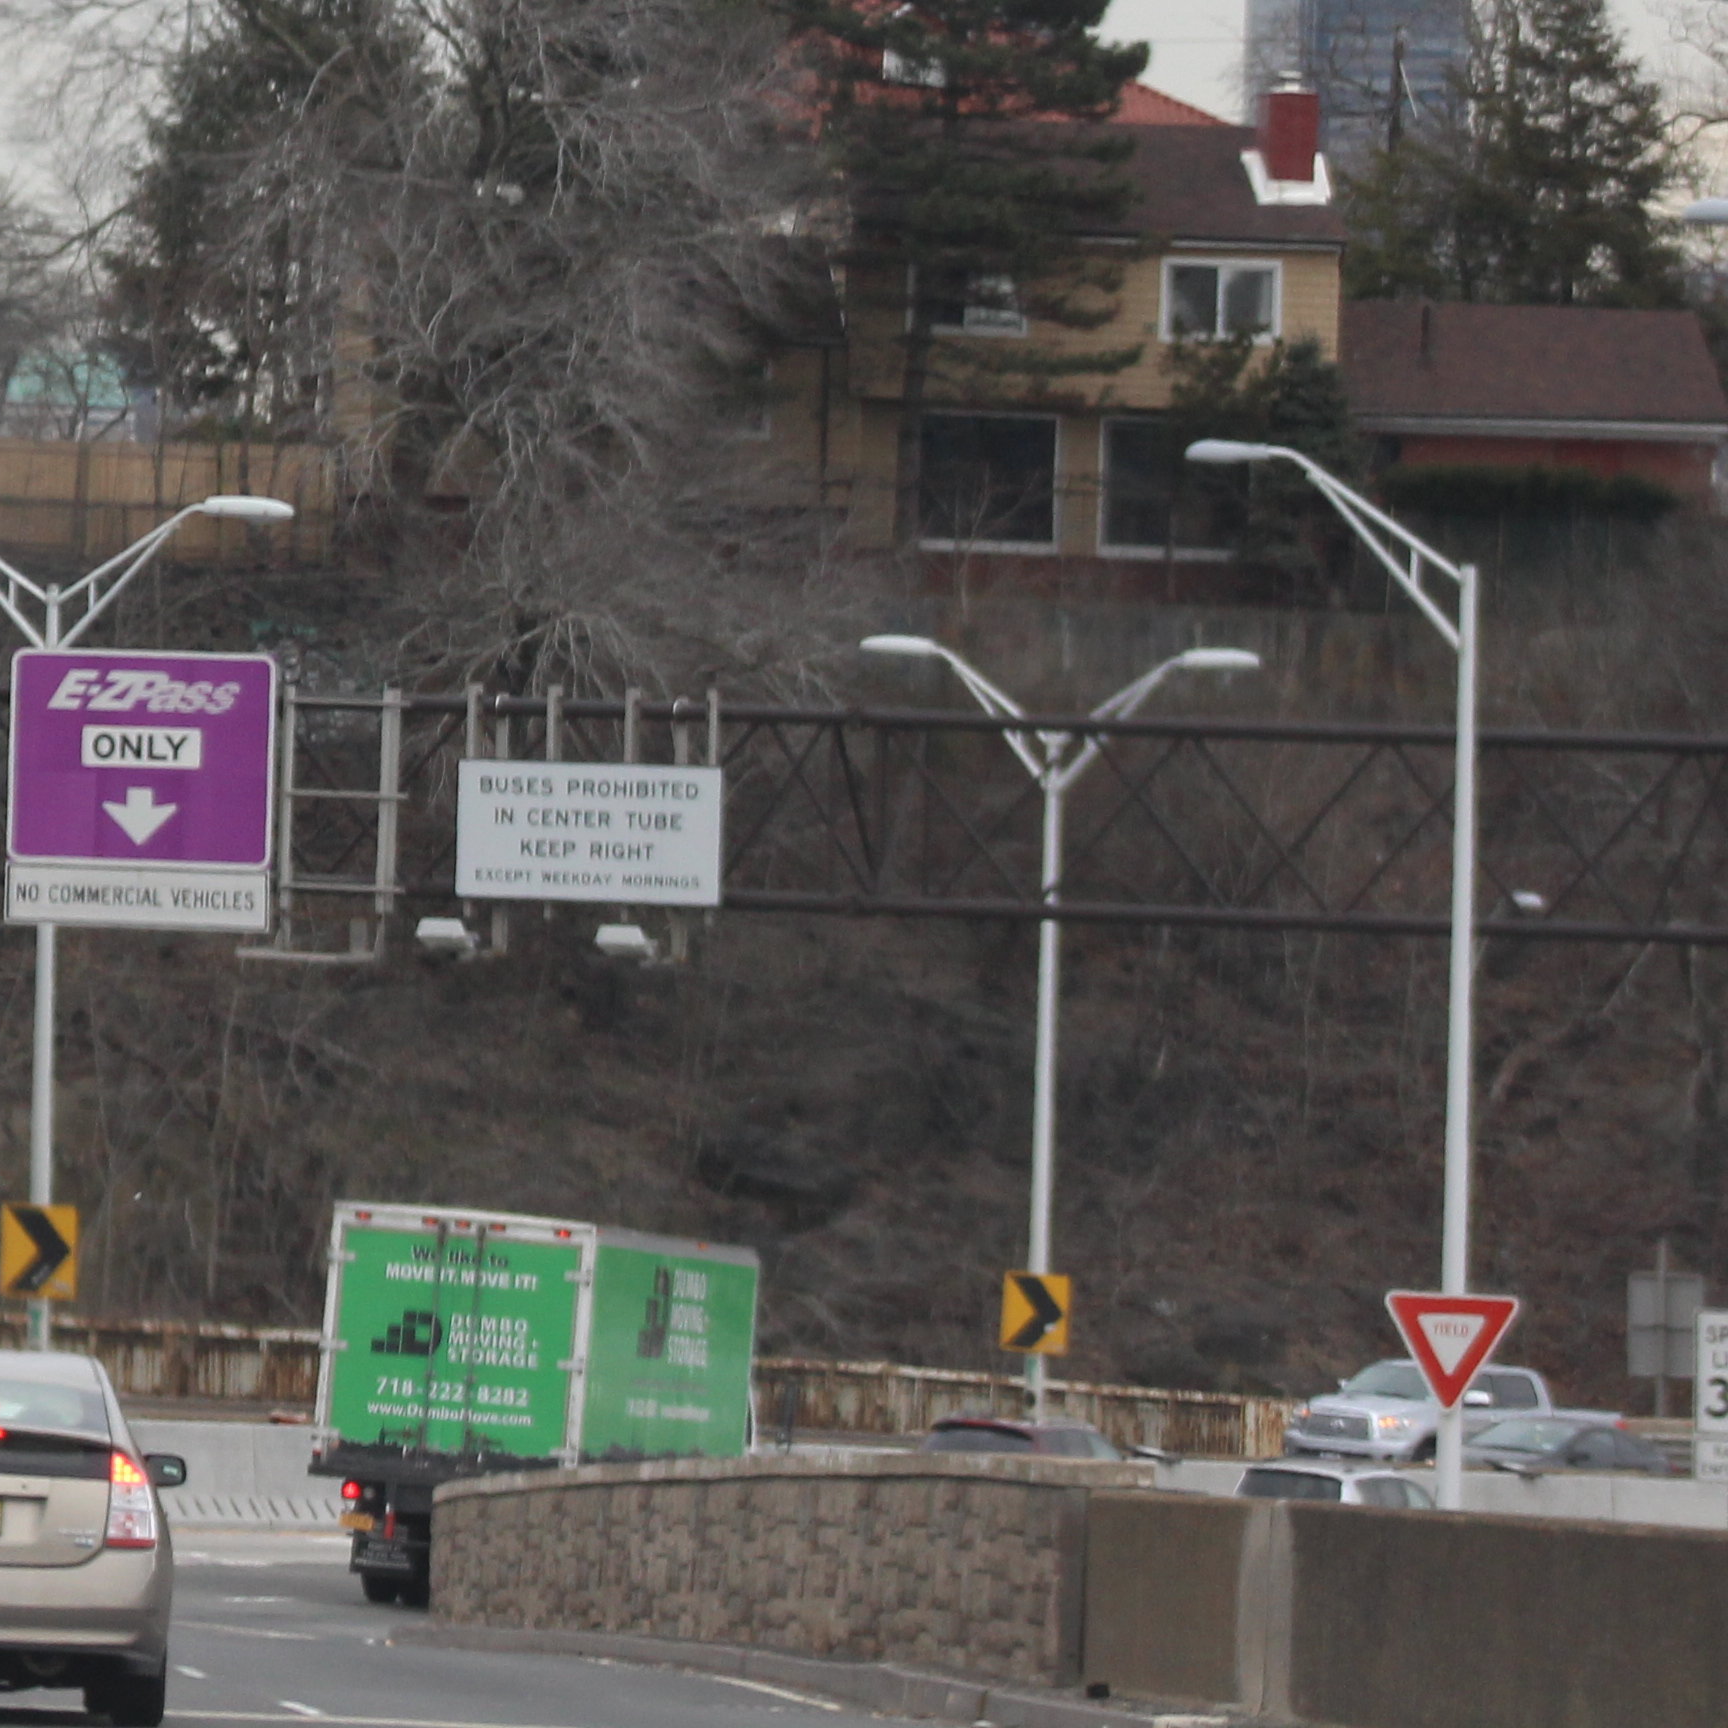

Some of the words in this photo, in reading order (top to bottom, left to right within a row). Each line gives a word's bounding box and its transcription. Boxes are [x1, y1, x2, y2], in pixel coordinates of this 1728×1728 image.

[47, 669, 240, 714] E-ZPass
[93, 733, 188, 761] ONLY
[479, 775, 553, 795] BUSES
[566, 778, 699, 800] PROHIBITED
[494, 807, 514, 824] IN
[526, 808, 611, 829] CENTER
[625, 811, 683, 831] TUBE
[520, 839, 576, 858] KEEP
[589, 841, 655, 861] RIGHT
[474, 868, 532, 882] EXCEPT
[541, 871, 612, 886] WEEKDAY
[621, 874, 700, 890] MORNINGS
[15, 884, 39, 902] NO
[48, 884, 162, 908] COMMERCIAL
[170, 889, 255, 911] VEHICLES
[386, 1262, 435, 1283] MOVE
[460, 1268, 510, 1289] MOVE
[450, 1313, 528, 1333] DUMBO
[1433, 1321, 1469, 1338] YIELD
[448, 1330, 525, 1350] MOVING
[447, 1347, 538, 1370] STORAGE
